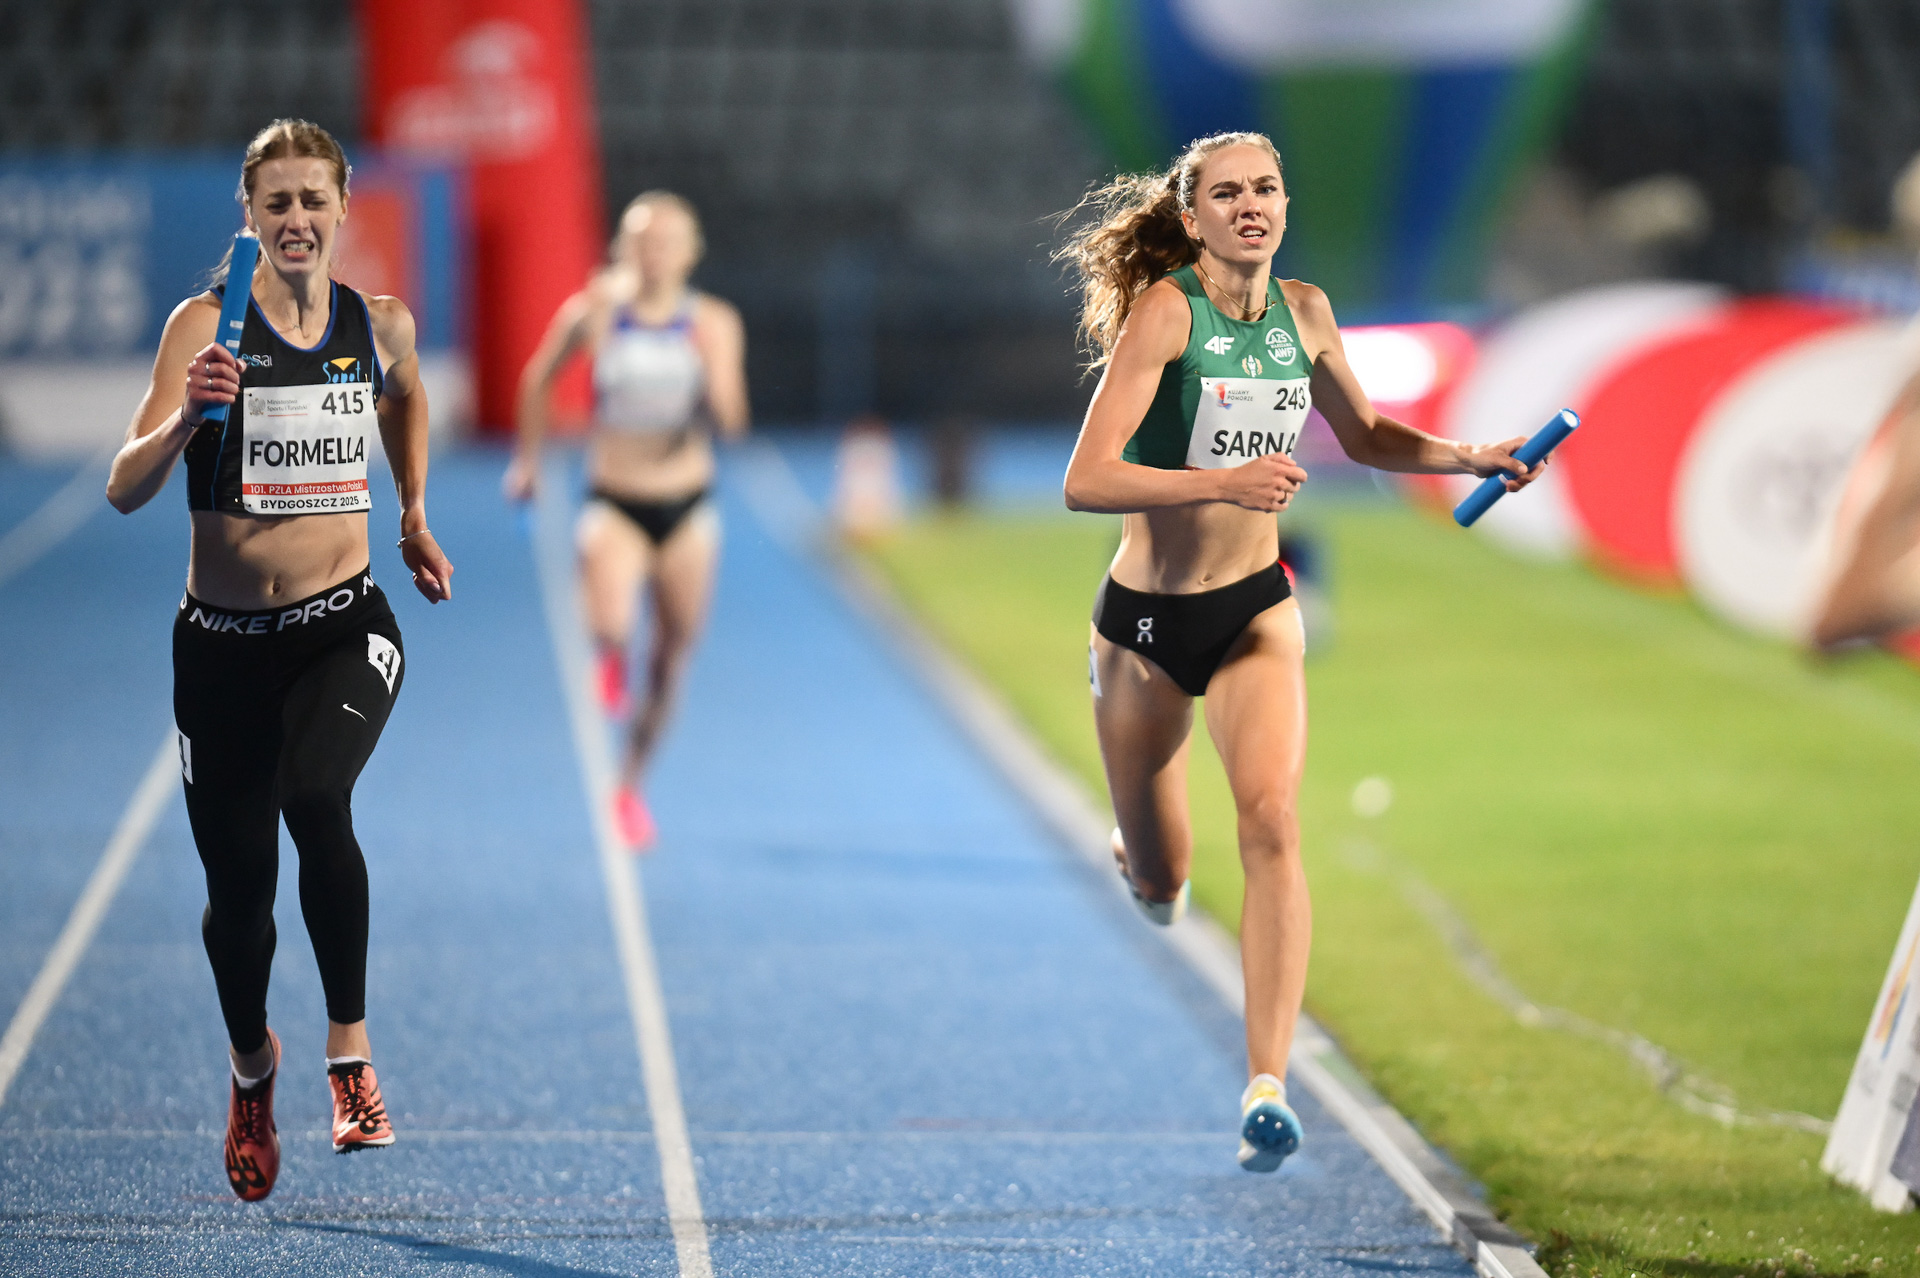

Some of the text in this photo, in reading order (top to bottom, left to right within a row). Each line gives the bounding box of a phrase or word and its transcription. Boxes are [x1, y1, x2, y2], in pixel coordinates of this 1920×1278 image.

[1204, 335, 1235, 355] 4F
[321, 390, 364, 415] 415
[1273, 386, 1306, 411] 243
[250, 436, 364, 466] FORMELLA
[1211, 430, 1295, 457] SARNA
[250, 481, 364, 495] 101. PZLA Mistrzostwa Polski
[260, 495, 360, 509] BYDGOSZCZ 2025
[188, 607, 272, 635] NIKE
[276, 588, 354, 632] PRO
